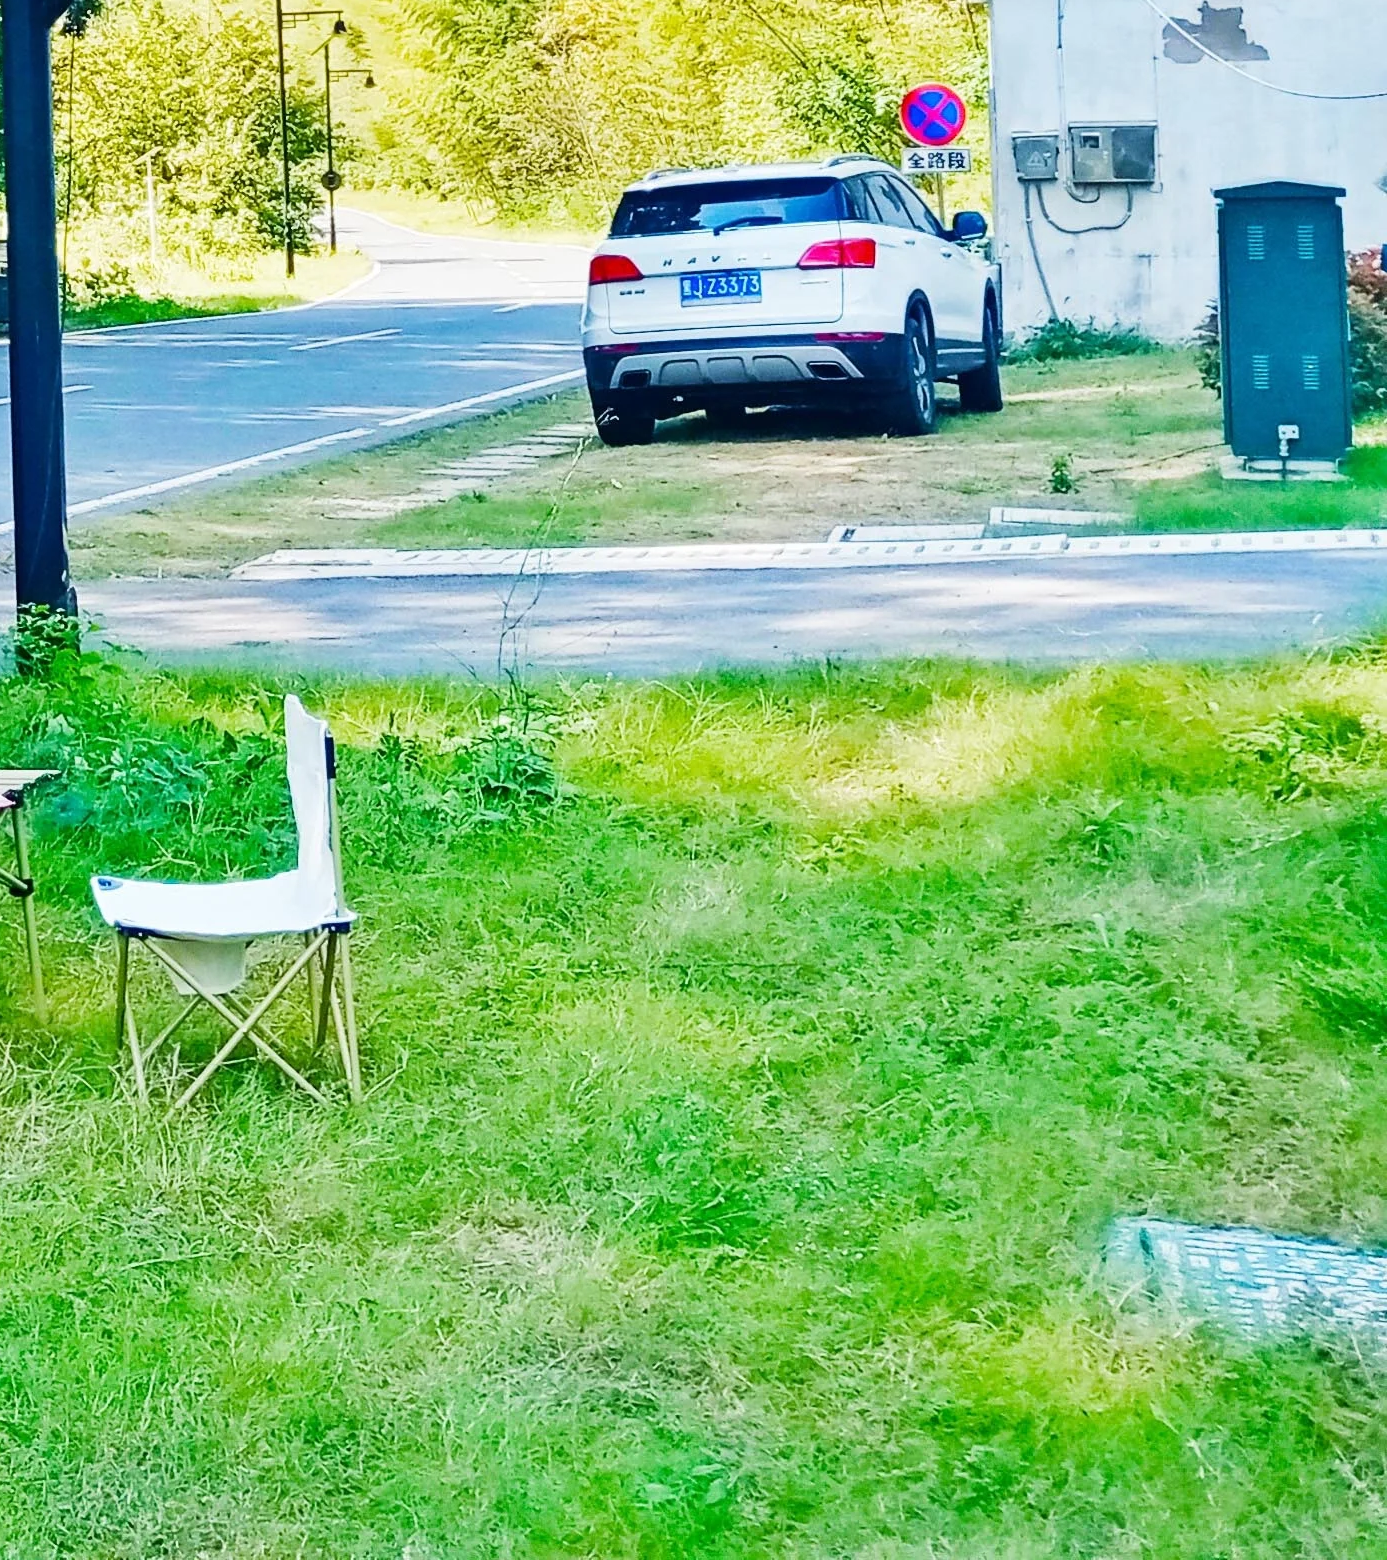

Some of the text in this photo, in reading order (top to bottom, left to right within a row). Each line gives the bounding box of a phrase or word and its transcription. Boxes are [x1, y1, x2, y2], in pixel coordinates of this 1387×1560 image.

[907, 152, 966, 169] 全路段
[663, 255, 772, 267] HAV
